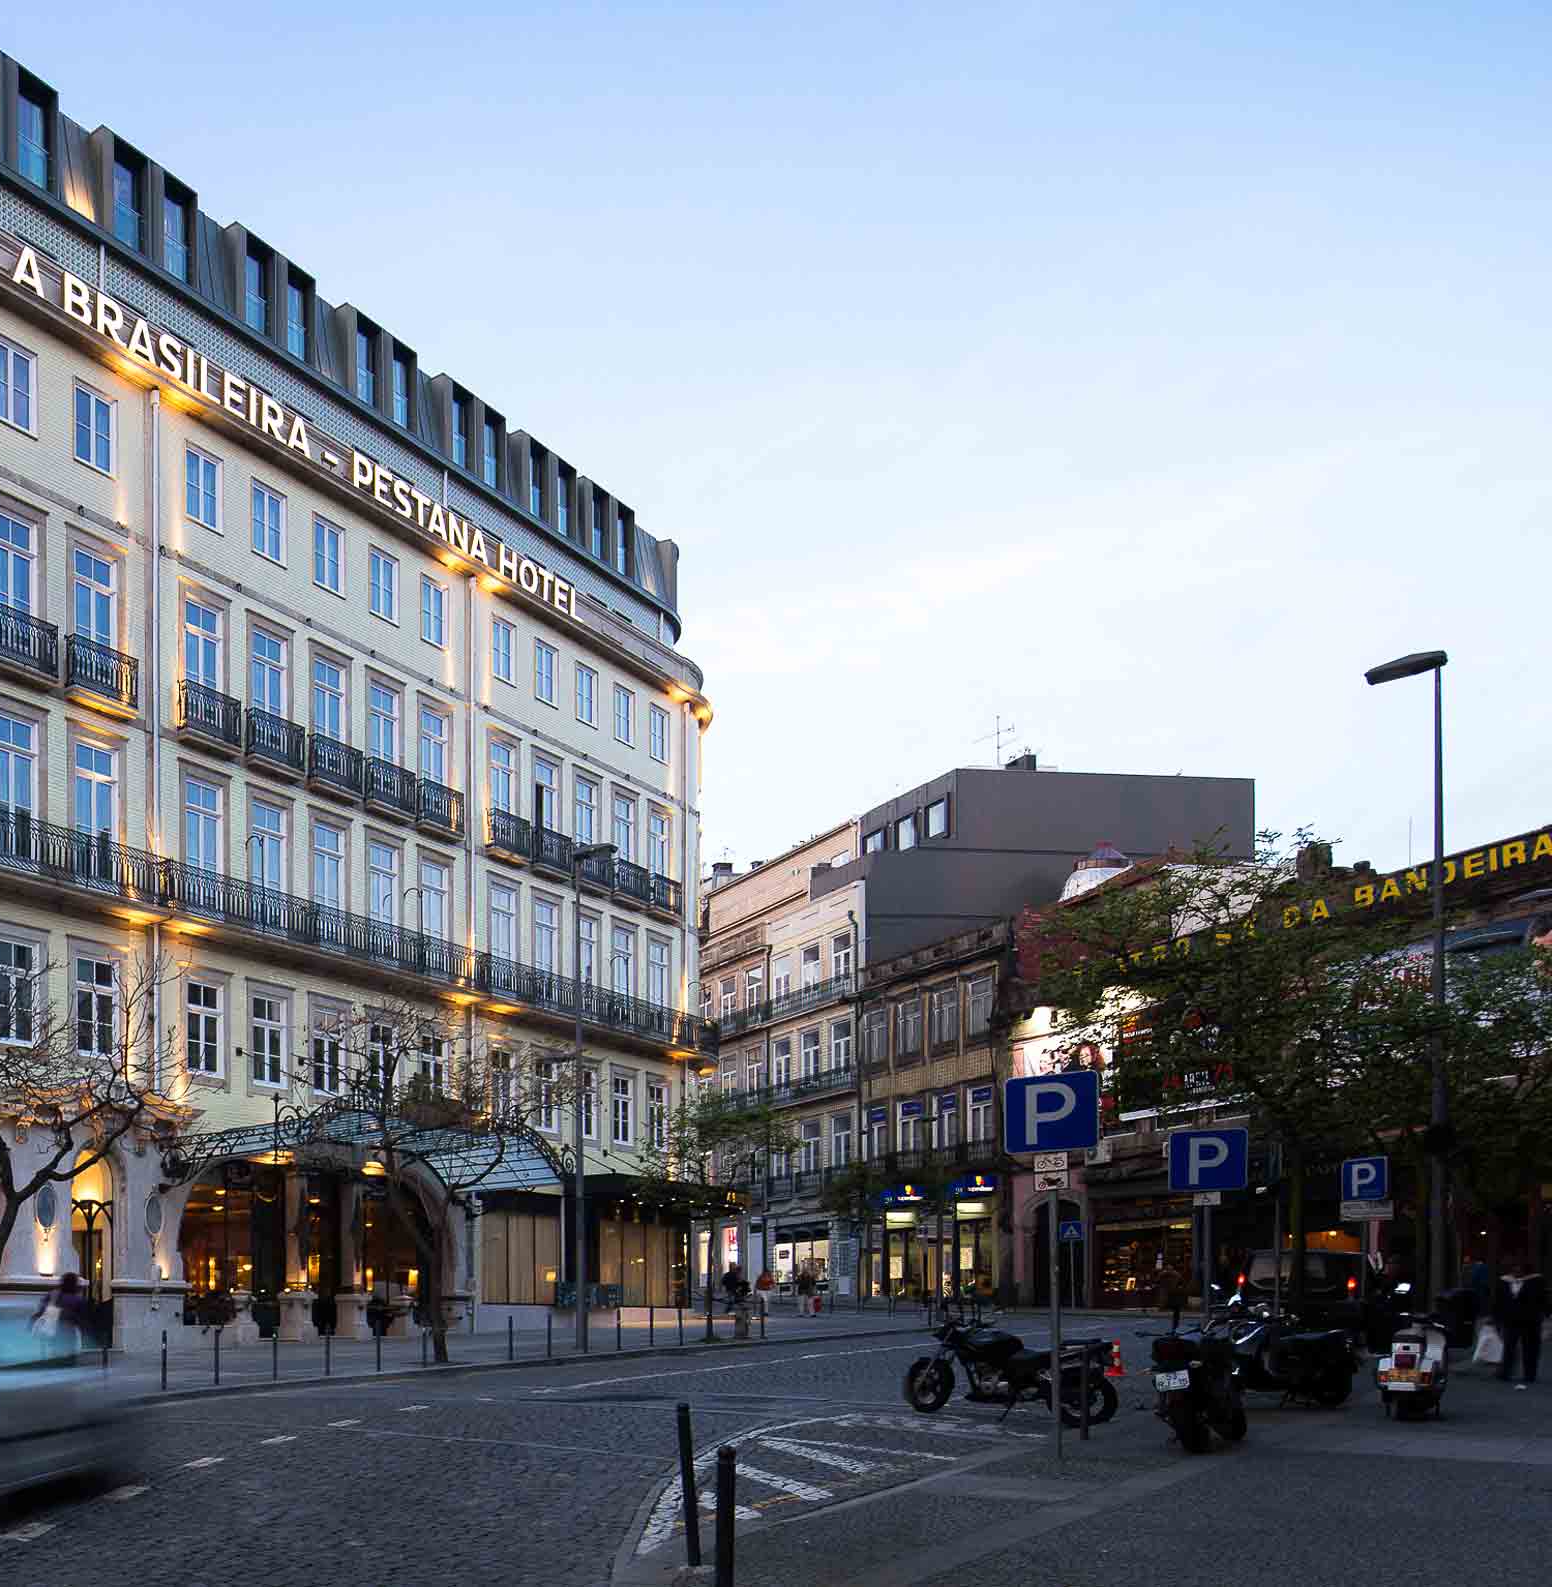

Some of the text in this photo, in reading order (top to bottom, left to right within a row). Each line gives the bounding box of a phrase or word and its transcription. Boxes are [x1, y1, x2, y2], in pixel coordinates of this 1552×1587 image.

[12, 245, 46, 300] A
[62, 269, 312, 460] BRASILEIRA
[351, 448, 489, 568] PESTANA
[496, 541, 586, 622] HOTEL
[1352, 832, 1552, 909] BANDEIRA
[1025, 1082, 1076, 1145] P
[1188, 1136, 1229, 1185] P
[1352, 1162, 1376, 1198] P
